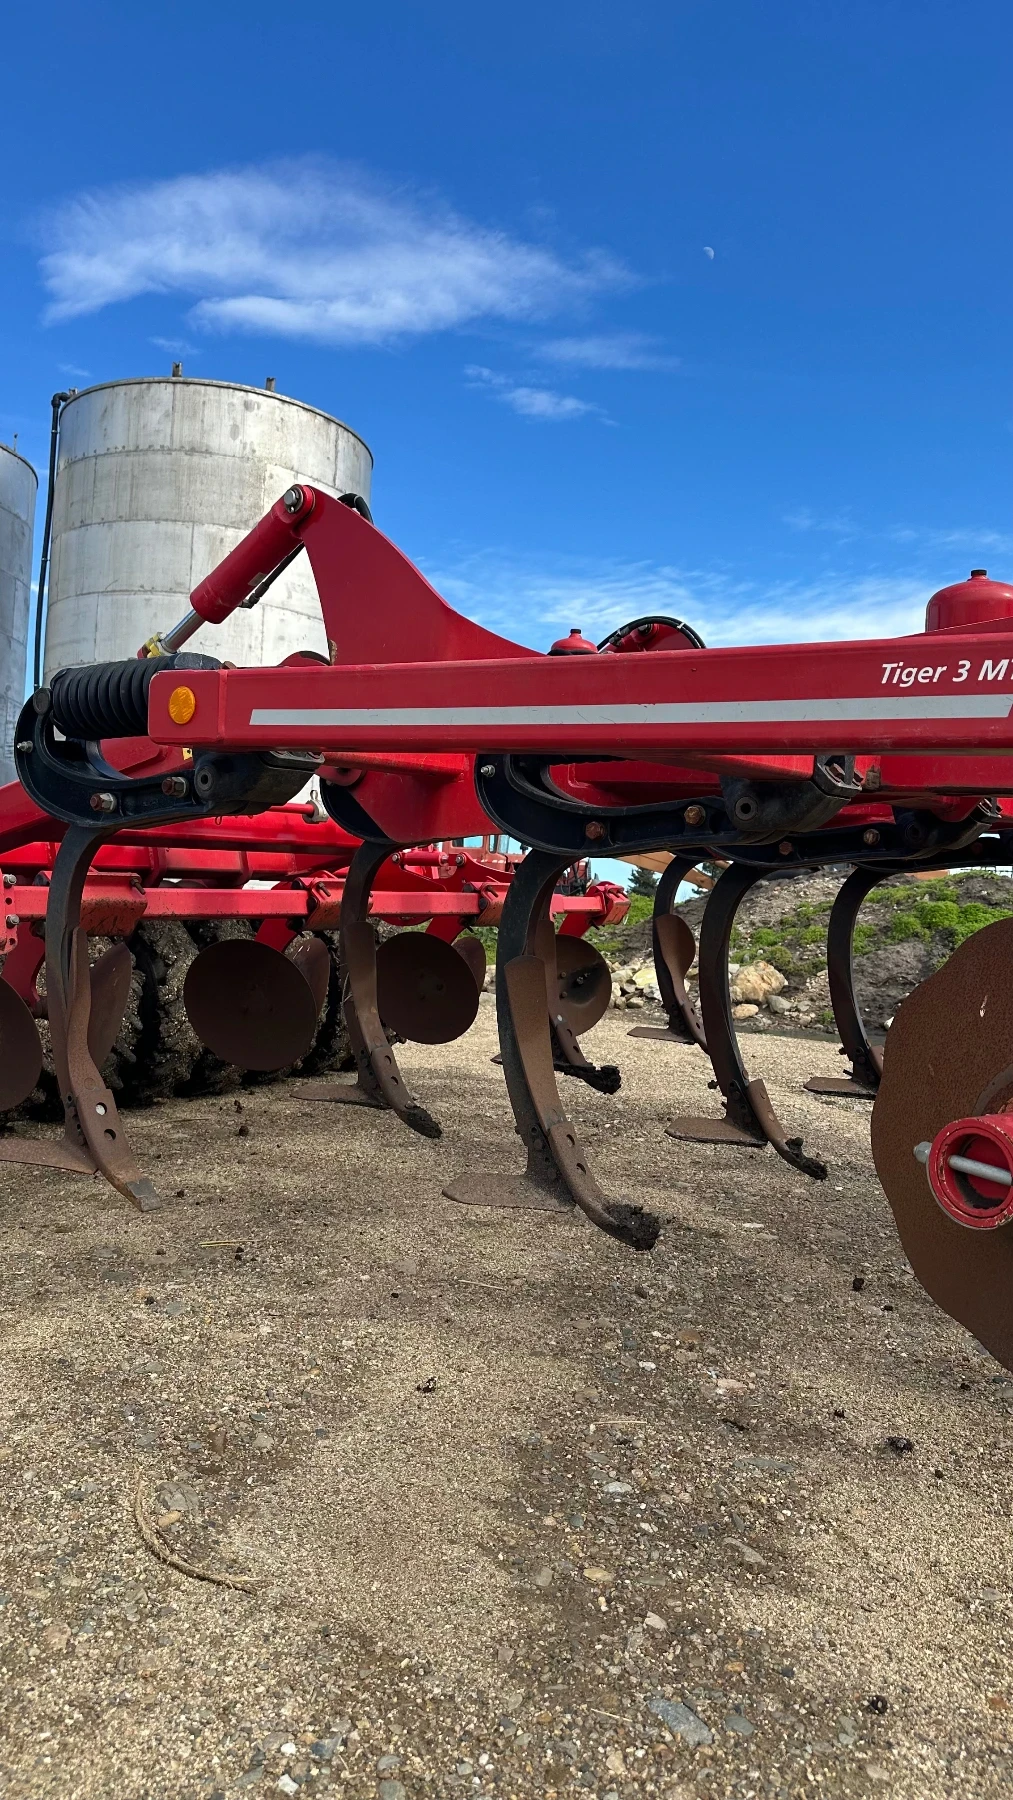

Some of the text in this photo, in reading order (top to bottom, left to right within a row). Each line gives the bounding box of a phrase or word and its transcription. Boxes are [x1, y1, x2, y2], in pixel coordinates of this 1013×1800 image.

[881, 658, 1013, 688] Tiger 3 M
